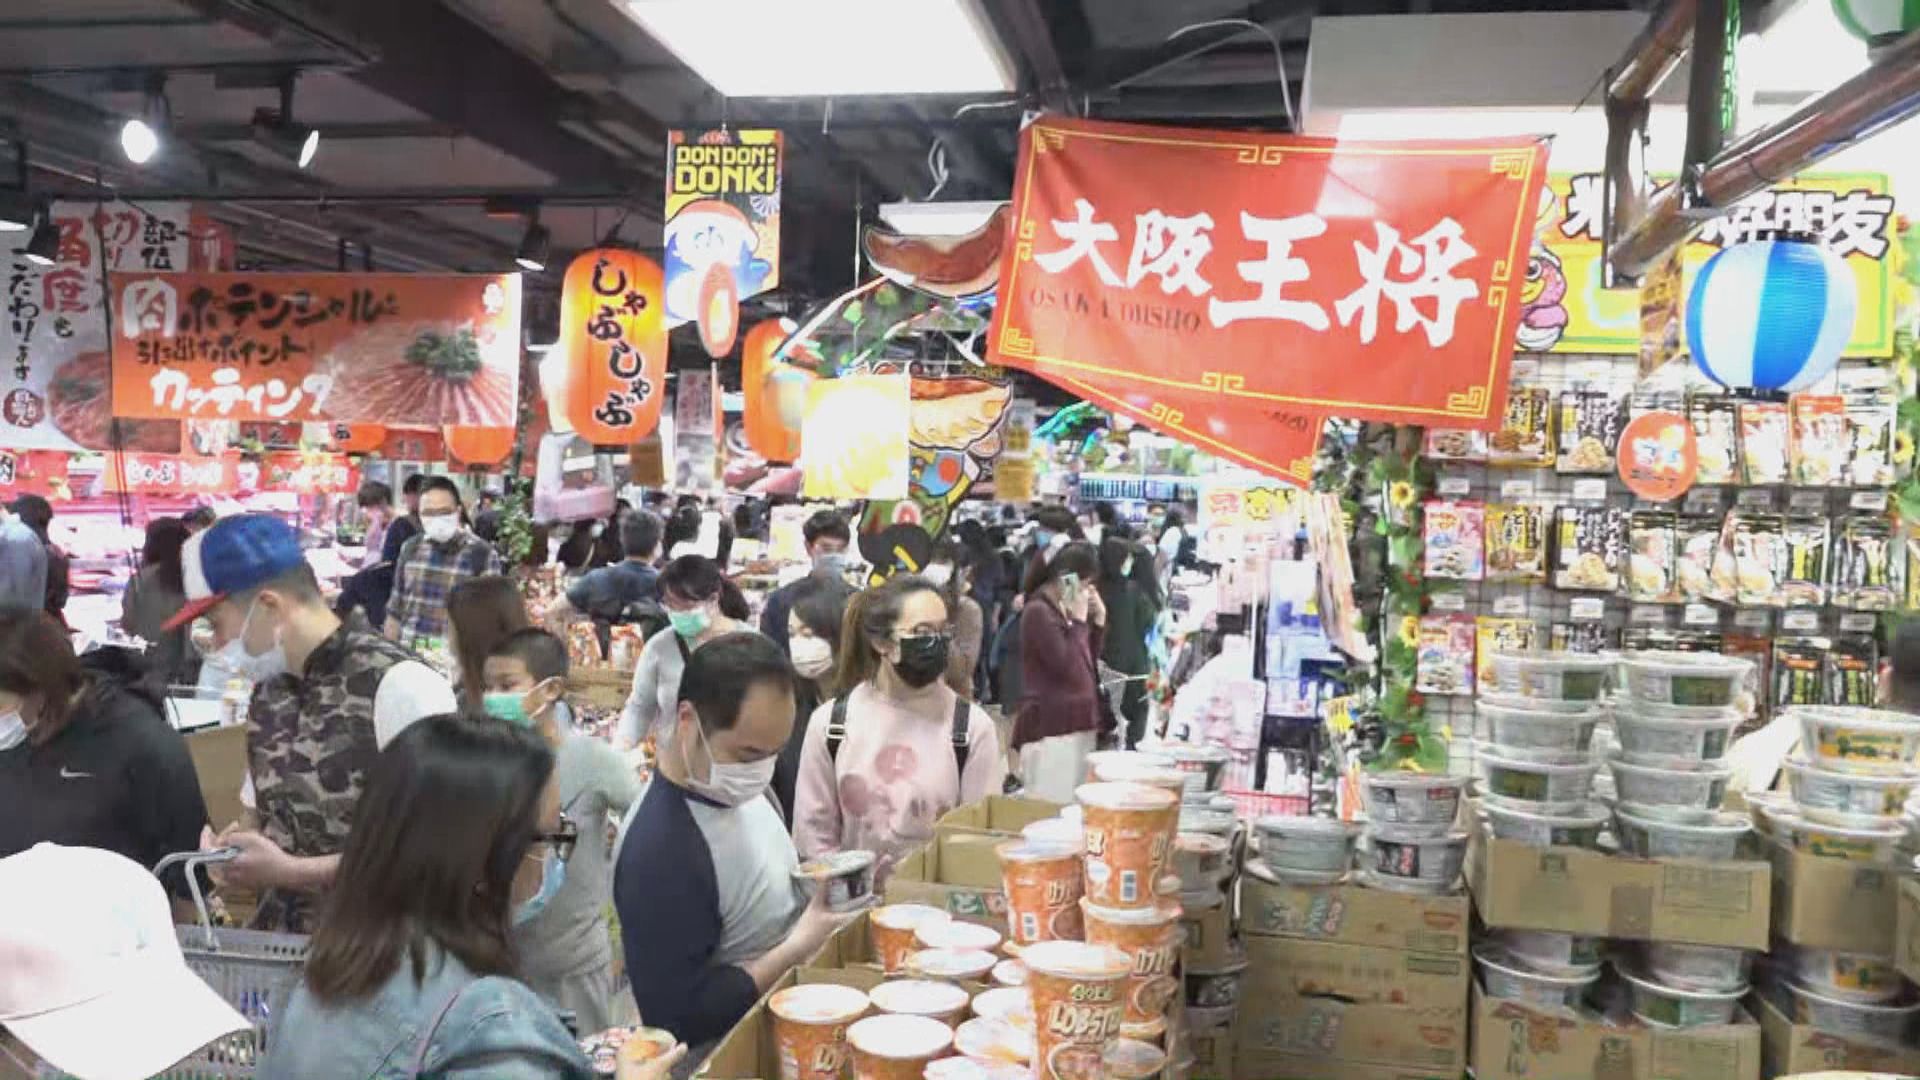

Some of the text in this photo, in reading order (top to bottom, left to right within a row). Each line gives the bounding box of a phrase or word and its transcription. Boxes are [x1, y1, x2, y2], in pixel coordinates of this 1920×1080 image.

[676, 145, 720, 164] DON
[588, 259, 651, 427] しゃぶしゃぶ
[1034, 199, 1479, 348] 大阪王将
